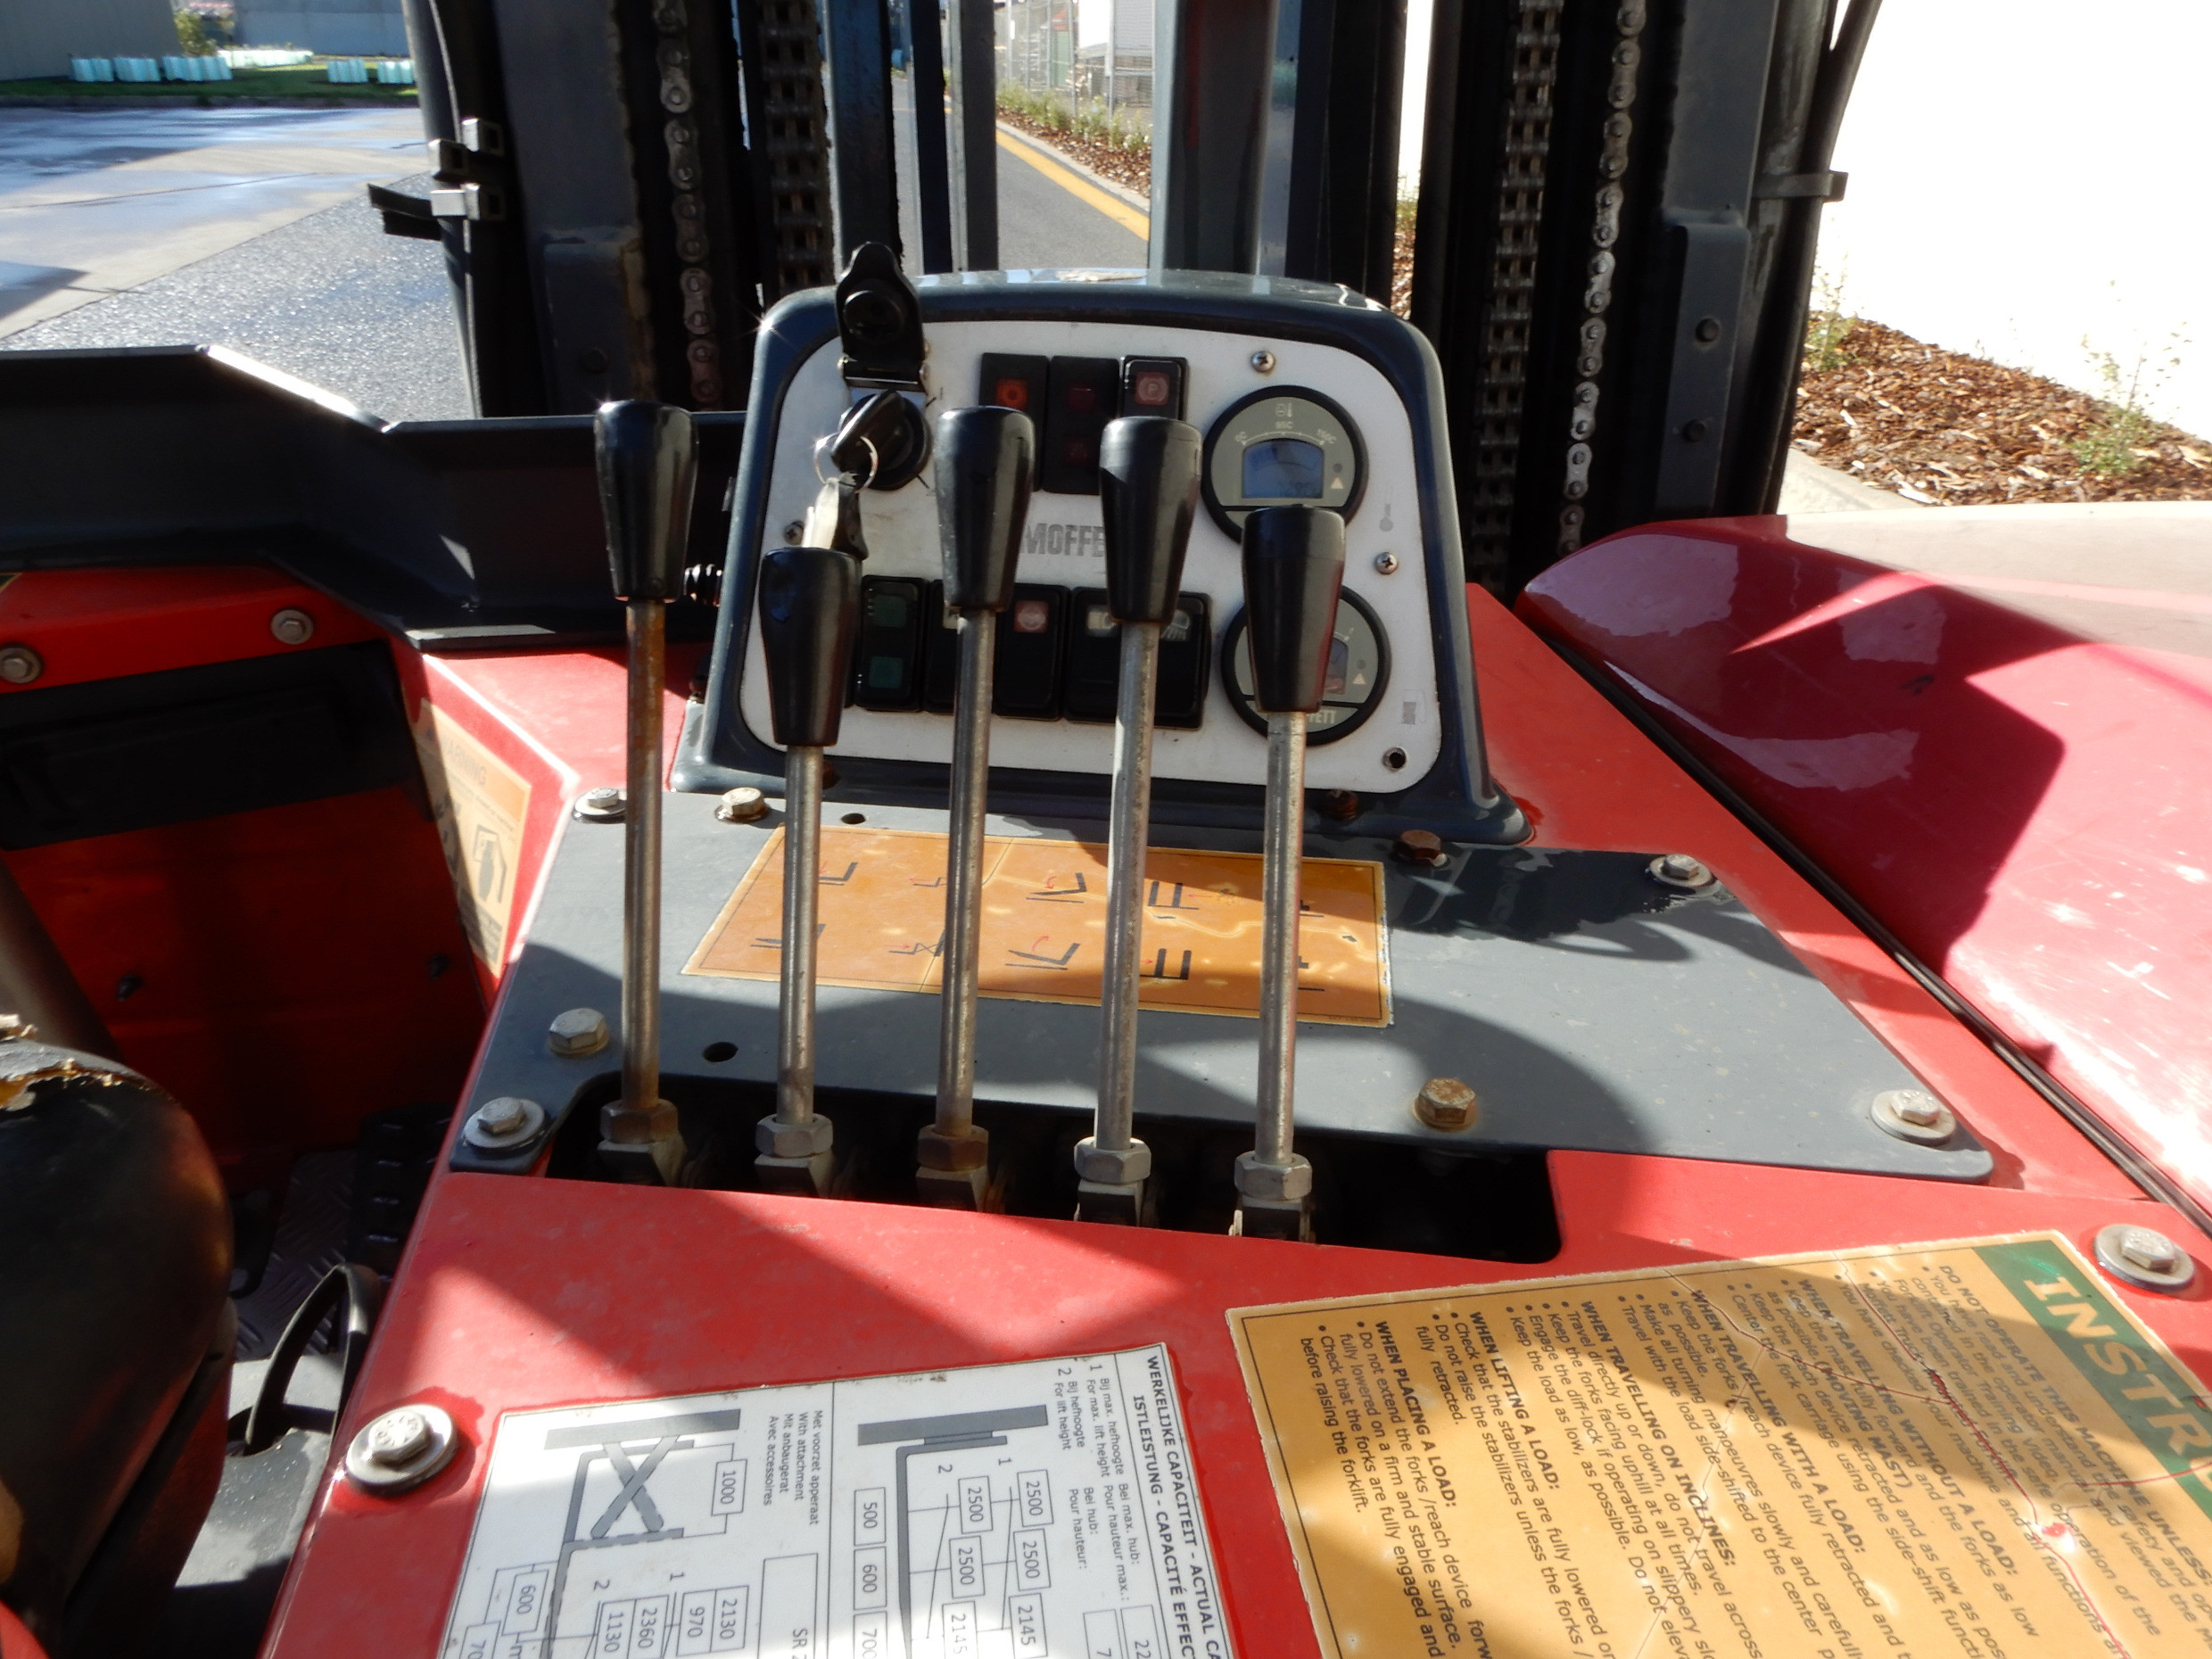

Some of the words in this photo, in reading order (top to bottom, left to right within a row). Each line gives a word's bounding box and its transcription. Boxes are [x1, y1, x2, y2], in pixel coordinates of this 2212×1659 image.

[1336, 1333, 1361, 1361] fully
[1358, 1331, 1377, 1349] Do
[1374, 1320, 1403, 1365] WHEN
[1467, 1310, 1499, 1354] WHEN
[1564, 1309, 1596, 1348] Travel
[1057, 1366, 1071, 1377] 2
[1300, 1336, 1326, 1379] before
[1318, 1334, 1345, 1375] Check
[1366, 1352, 1387, 1374] not
[1053, 1381, 1066, 1399] For
[1085, 1378, 1098, 1395] For
[1333, 1376, 1356, 1406] that
[1349, 1363, 1382, 1416] lowered
[1412, 1325, 1438, 1353] fully
[1429, 1359, 1469, 1424] retracted.
[1490, 1357, 1531, 1420] LIFTING
[1583, 1349, 1624, 1399] directly
[1056, 1399, 1069, 1415] lift
[1088, 1396, 1101, 1422] max.
[1102, 1391, 1115, 1417] max.
[1312, 1382, 1342, 1427] raising
[1375, 1376, 1406, 1424] extend
[1392, 1367, 1432, 1436] PLACING
[1611, 1402, 1633, 1421] up
[767, 1415, 778, 1440] Avec
[782, 1413, 793, 1431] Mit
[797, 1411, 807, 1437] With
[813, 1409, 822, 1430] Met
[1056, 1415, 1073, 1450] height
[1067, 1394, 1088, 1449] hefhoogte
[1093, 1424, 1106, 1441] lift
[1344, 1407, 1366, 1432] the
[1369, 1419, 1387, 1438] on
[1519, 1423, 1539, 1435] A
[1579, 1300, 1614, 1342] WHEN
[1604, 1344, 1669, 1440] TRAVELLING
[1658, 1443, 1685, 1469] ON
[1674, 1473, 1739, 1566] INCLINES:
[1625, 1424, 1644, 1440] or
[1687, 1288, 1726, 1332] WHEN
[1716, 1333, 1787, 1427] TRAVELLING
[1778, 1431, 1820, 1478] WITH
[1810, 1482, 1832, 1495] A
[1821, 1498, 1869, 1553] LOAD:
[1795, 1278, 1836, 1320] WHEN
[1826, 1321, 1906, 1416] TRAVELLING
[1895, 1417, 1967, 1498] WITHOUT
[1956, 1501, 1978, 1515] A
[1969, 1519, 2022, 1575] LOAD:
[811, 1431, 821, 1473] voorzet
[1104, 1419, 1127, 1476] hefhoogte
[1330, 1430, 1352, 1455] the
[1353, 1434, 1380, 1473] forks
[1377, 1441, 1391, 1451] a
[1394, 1427, 1416, 1451] the
[1420, 1439, 1438, 1452] A
[1543, 1312, 1574, 1344] Keep
[1564, 1346, 1587, 1367] the
[1576, 1370, 1606, 1405] forks
[1593, 1407, 1630, 1450] facing
[1617, 1454, 1655, 1495] uphill
[1643, 1498, 1665, 1516] at
[1654, 1519, 1678, 1539] all
[1666, 1542, 1708, 1596] times.
[763, 1442, 776, 1506] accessoires
[777, 1431, 792, 1494] anbaugerat
[794, 1437, 806, 1501] attachment
[937, 1463, 953, 1474] 2
[1094, 1441, 1111, 1478] height
[1382, 1455, 1407, 1486] firm
[1405, 1455, 1432, 1493] forks
[1527, 1439, 1564, 1490] LOAD:
[1633, 1442, 1673, 1488] down,
[719, 1468, 736, 1506] 1000
[806, 1473, 821, 1526] apperaat
[1025, 1479, 1043, 1517] 2500
[1102, 1483, 1117, 1511] Pour
[1131, 1393, 1163, 1496] ISTLEISTUNG
[1154, 1509, 1188, 1596] CAPACITÉ
[1340, 1457, 1371, 1513] forklift.
[1367, 1476, 1387, 1502] are
[1426, 1456, 1460, 1507] LOAD:
[863, 1500, 878, 1530] 500
[967, 1485, 984, 1523] 2500
[1068, 1488, 1081, 1515] Pour
[1121, 1506, 1135, 1534] max.
[1395, 1490, 1419, 1519] and
[1663, 1491, 1687, 1512] do
[1085, 1507, 1100, 1535] hub:
[1107, 1513, 1125, 1562] hauteur
[1374, 1505, 1404, 1540] fully
[1417, 1497, 1454, 1548] /reach
[1675, 1515, 1704, 1545] not
[1021, 1539, 1040, 1580] 2500
[1071, 1517, 1089, 1570] hauteur:
[1126, 1536, 1142, 1565] hub:
[1165, 1449, 1198, 1548] CAPACITEIT
[1187, 1563, 1216, 1635] ACTUAL
[1407, 1523, 1440, 1574] stable
[592, 1578, 610, 1591] 2
[862, 1563, 877, 1594] 600
[957, 1546, 975, 1587] 2500
[1389, 1544, 1432, 1619] engaged
[1441, 1553, 1477, 1609] device
[1692, 1547, 1733, 1597] travel
[515, 1583, 537, 1615] 600
[1426, 1578, 1467, 1649] surface.
[602, 1611, 624, 1654] 1130
[636, 1606, 657, 1649] 2360
[686, 1605, 705, 1638] 970
[717, 1597, 738, 1641] 2130
[790, 1626, 808, 1649] SR
[1017, 1603, 1036, 1647] 2145
[1418, 1622, 1446, 1658] and
